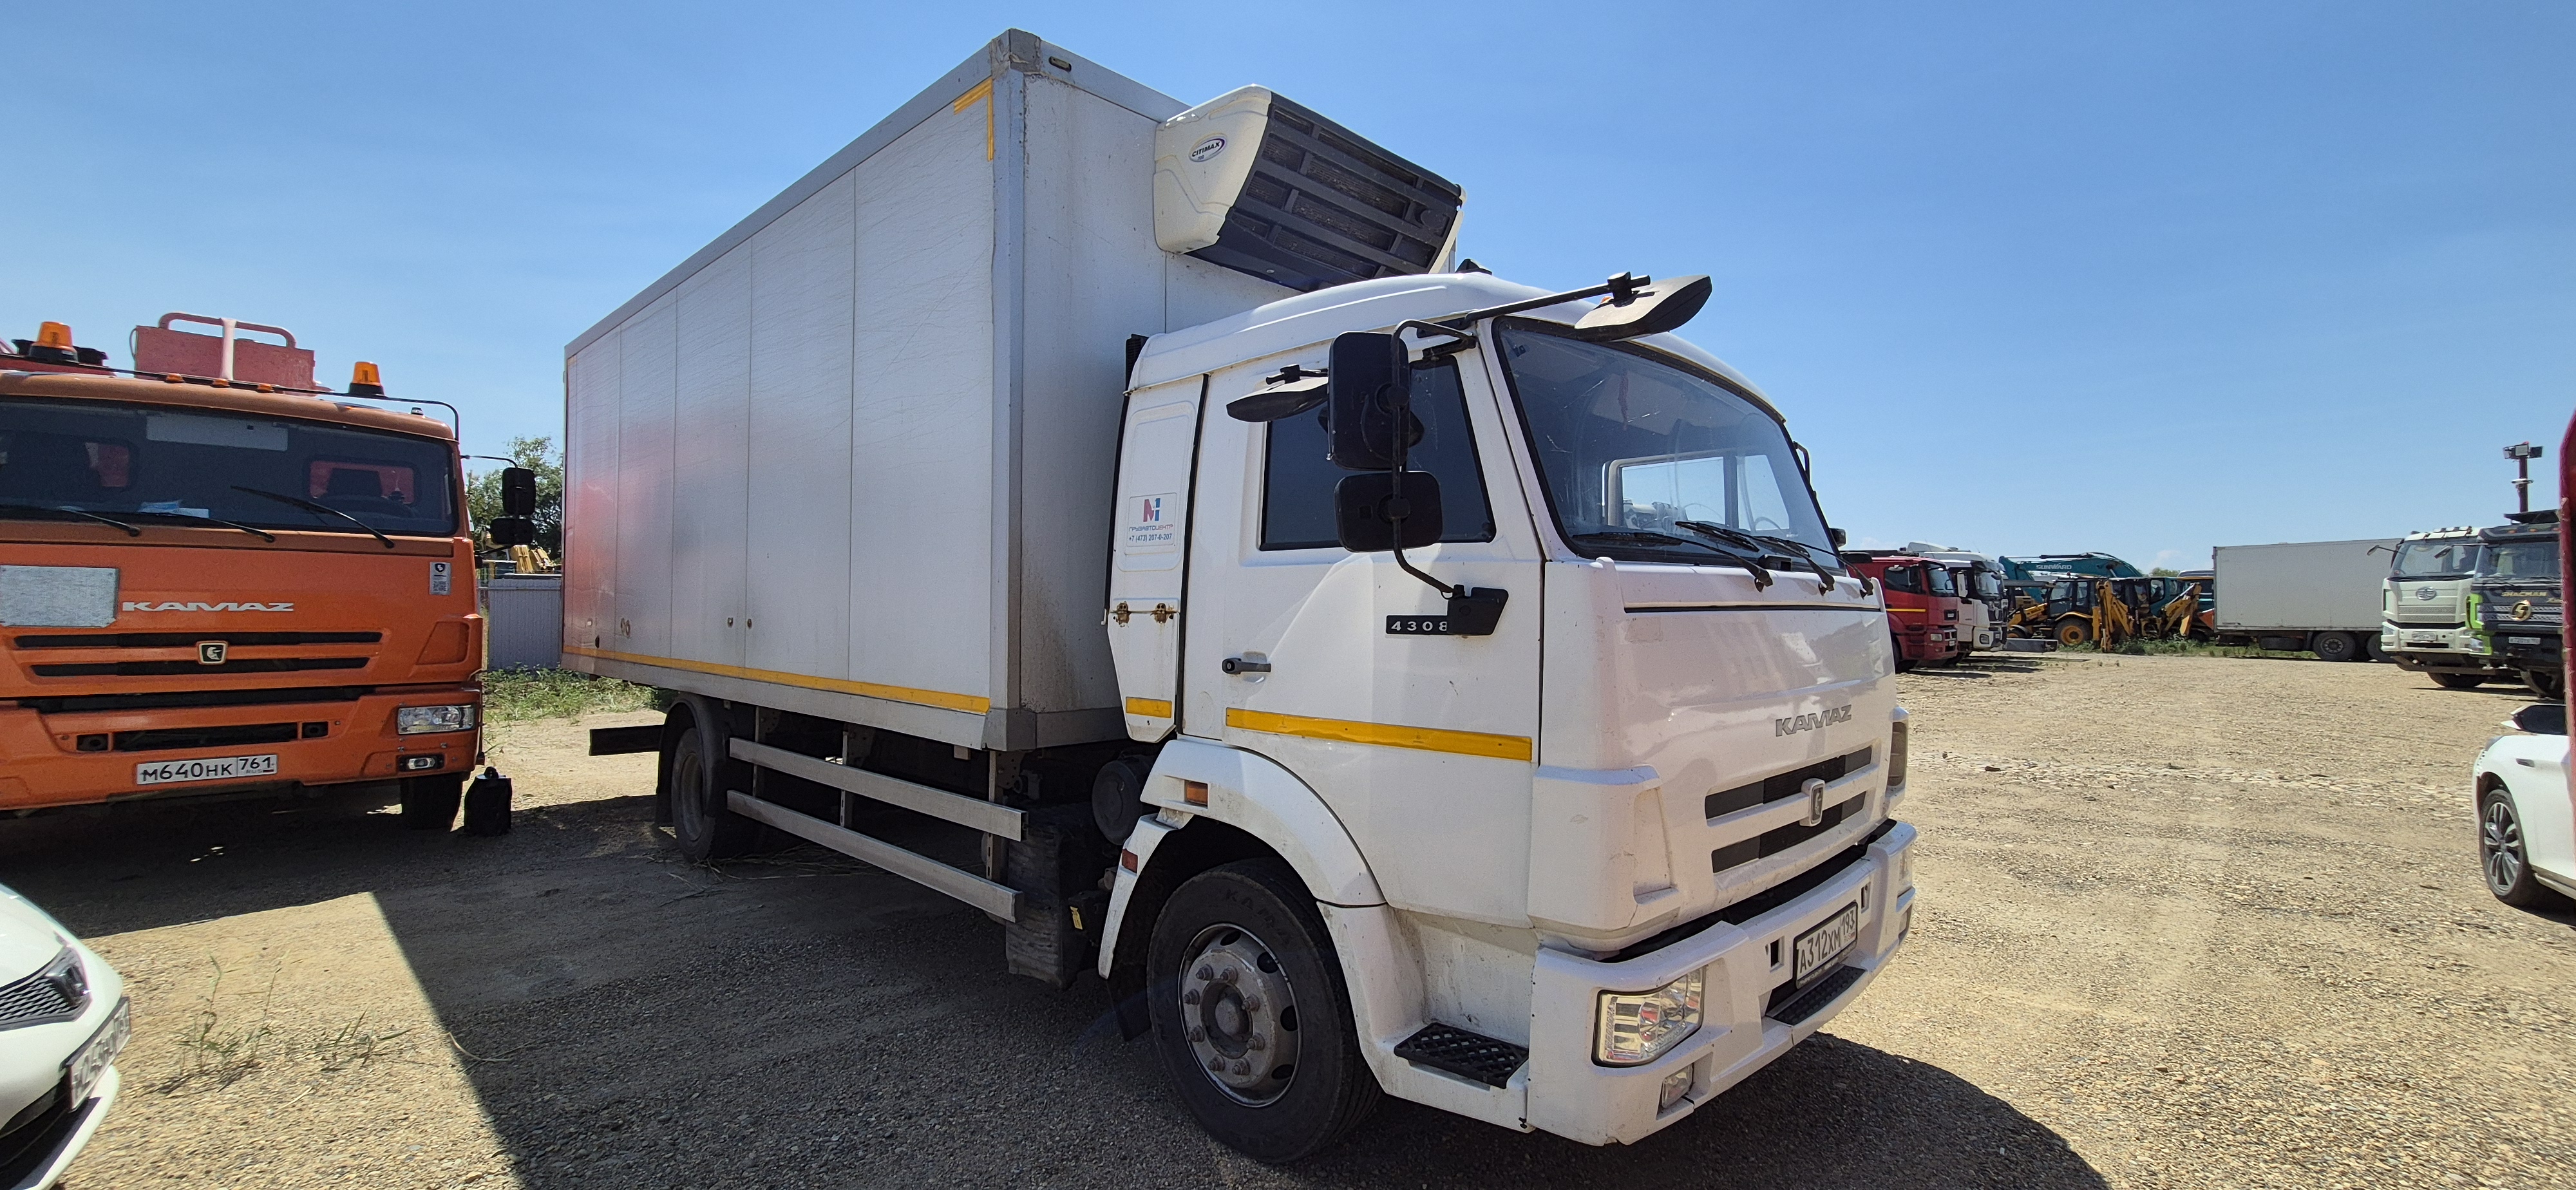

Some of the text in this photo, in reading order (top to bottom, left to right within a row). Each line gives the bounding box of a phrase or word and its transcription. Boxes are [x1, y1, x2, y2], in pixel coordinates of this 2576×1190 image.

[1192, 141, 1220, 157] CITIMAX
[1135, 534, 1148, 543] (473)
[122, 601, 294, 612] KAMAZ
[1391, 621, 1448, 632] 4308
[1776, 704, 1852, 737] KAMAZ
[239, 756, 271, 770] 761
[1799, 927, 1841, 974] А312ХМ
[1841, 909, 1855, 936] 193
